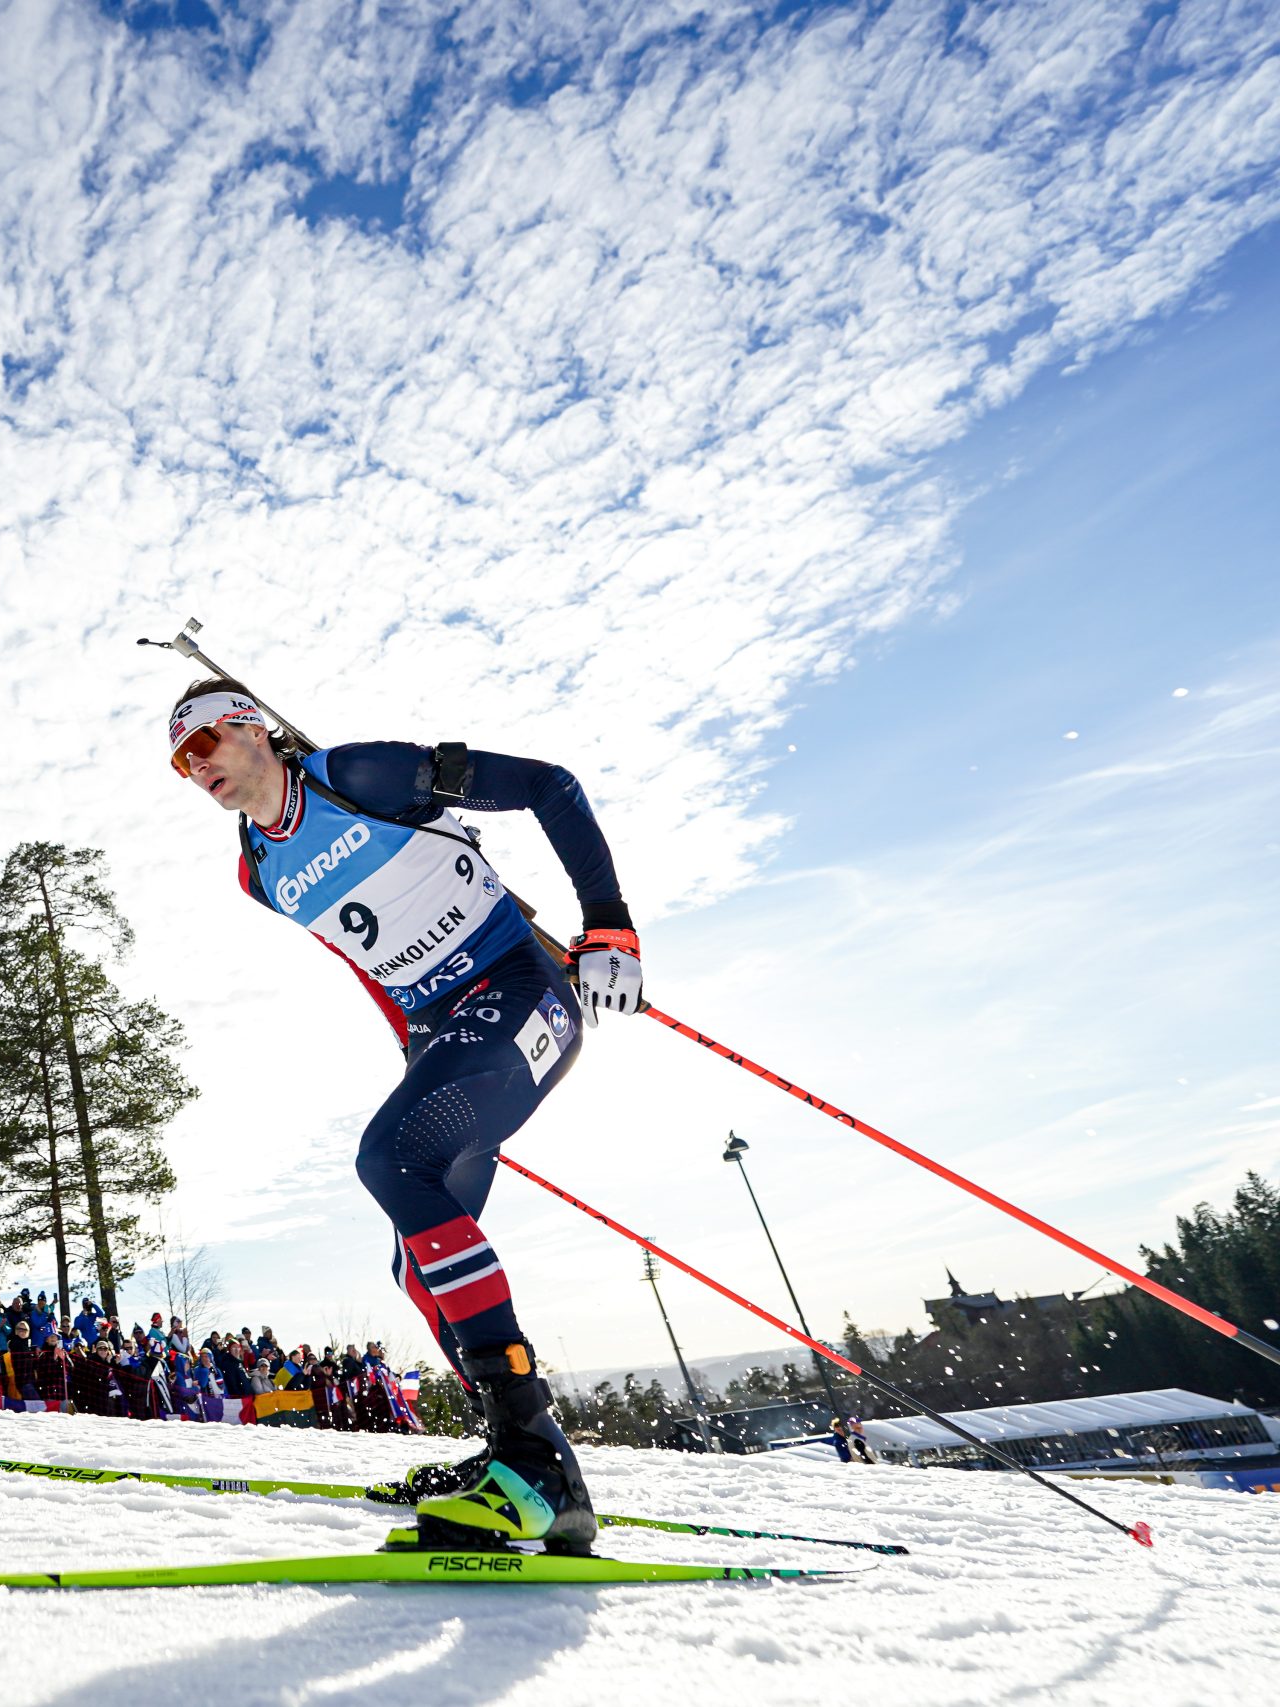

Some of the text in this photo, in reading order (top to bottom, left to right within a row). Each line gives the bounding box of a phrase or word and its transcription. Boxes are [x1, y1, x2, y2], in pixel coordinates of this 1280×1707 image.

[287, 793, 297, 819] CRAFT
[276, 822, 371, 915] CONRAD
[455, 854, 474, 885] 9
[339, 902, 379, 951] 9
[530, 1032, 550, 1062] 9
[428, 1556, 523, 1572] FISCHER
